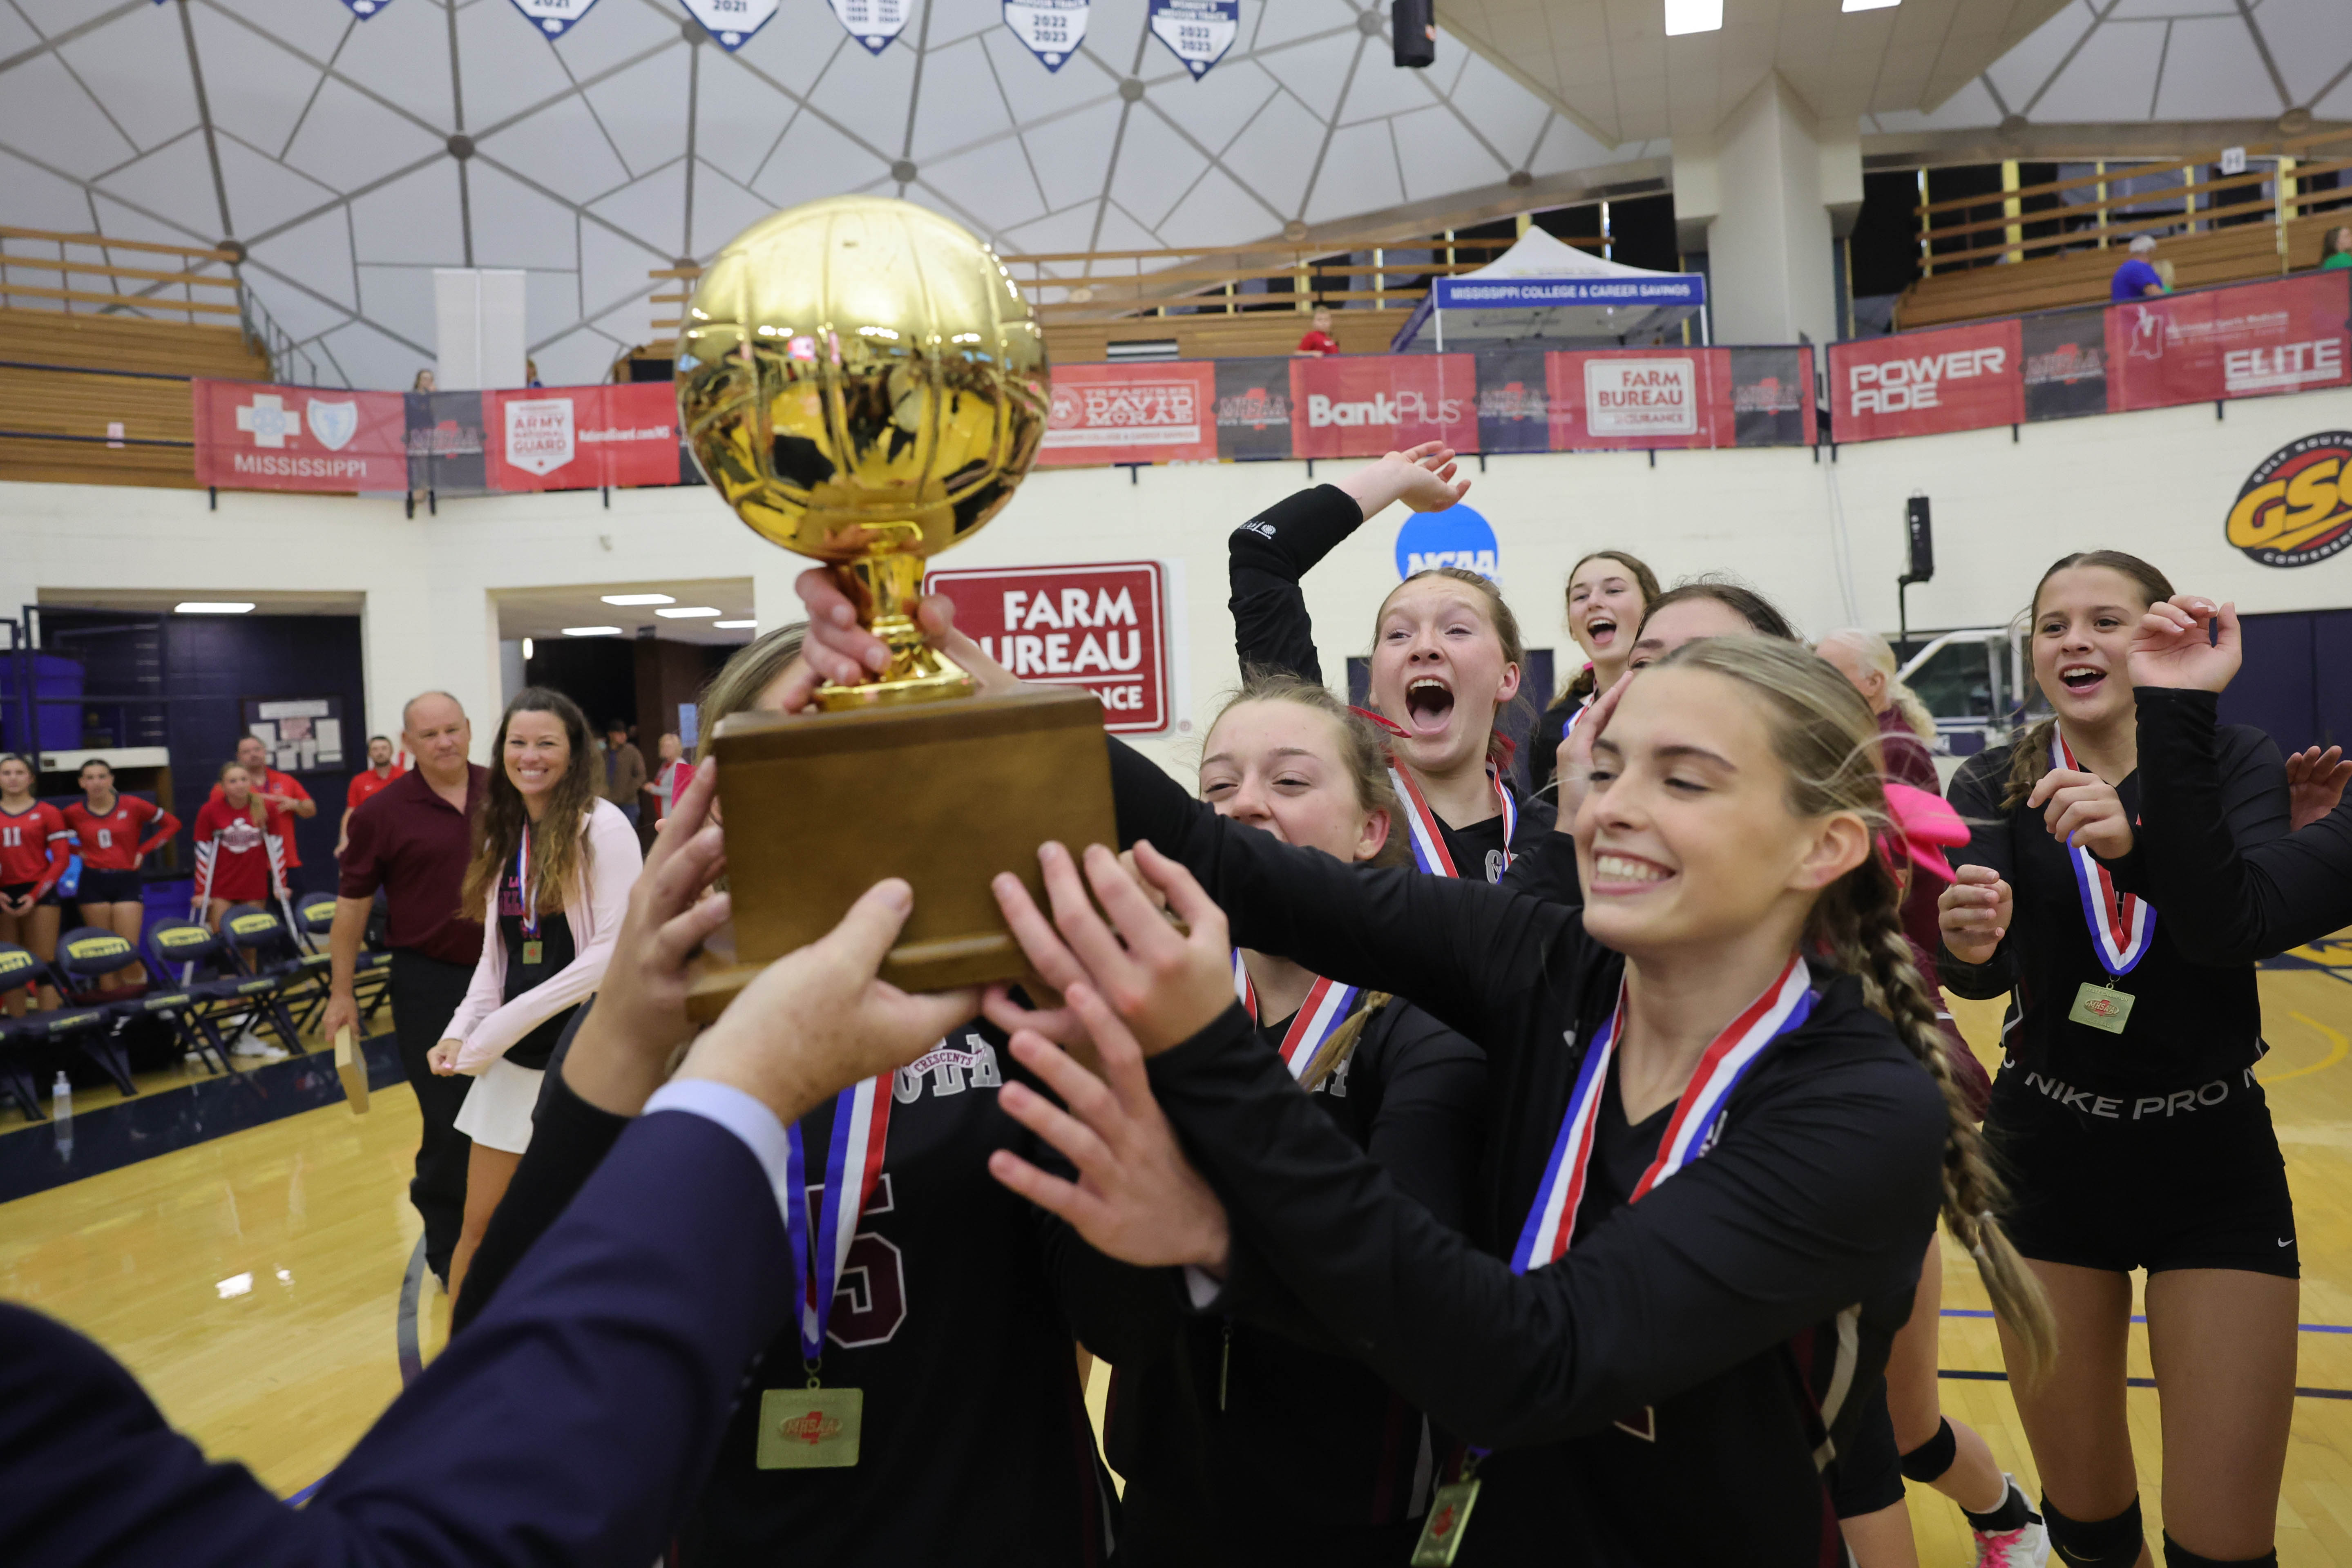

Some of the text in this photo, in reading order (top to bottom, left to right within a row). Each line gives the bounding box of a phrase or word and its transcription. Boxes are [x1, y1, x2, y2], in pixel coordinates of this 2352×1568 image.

[714, 1, 747, 12] 2021
[1033, 14, 1067, 27] 2022
[1035, 30, 1068, 42] 2023
[1180, 25, 1210, 38] 2022
[1451, 286, 1520, 299] MISSISSIPPI
[1521, 285, 1577, 299] COLLEGE
[1589, 284, 1639, 297] CAREER
[1639, 284, 1691, 297] SAVINGS
[2224, 337, 2343, 379] ELITE
[1849, 346, 2006, 391] POWER
[1622, 371, 1682, 387] FARM
[1086, 395, 1194, 413] DAVID
[1599, 390, 1683, 407] BUREAU
[1851, 382, 1938, 416] ADE
[1309, 391, 1462, 428] BankPlus
[515, 415, 565, 429] ARMY
[513, 439, 567, 453] GUARD
[234, 453, 367, 478] MISSISSIPPI
[2227, 454, 2352, 548] GS
[2263, 529, 2352, 565] CONFEREN
[1003, 586, 1139, 632] FARM
[971, 629, 1142, 675] UREAU
[3, 826, 22, 847] 11
[2088, 1001, 2115, 1013] MHSAA
[914, 1052, 973, 1072] CRESCENTS
[2024, 1072, 2123, 1119] NIKE
[2133, 1079, 2229, 1120] PRO
